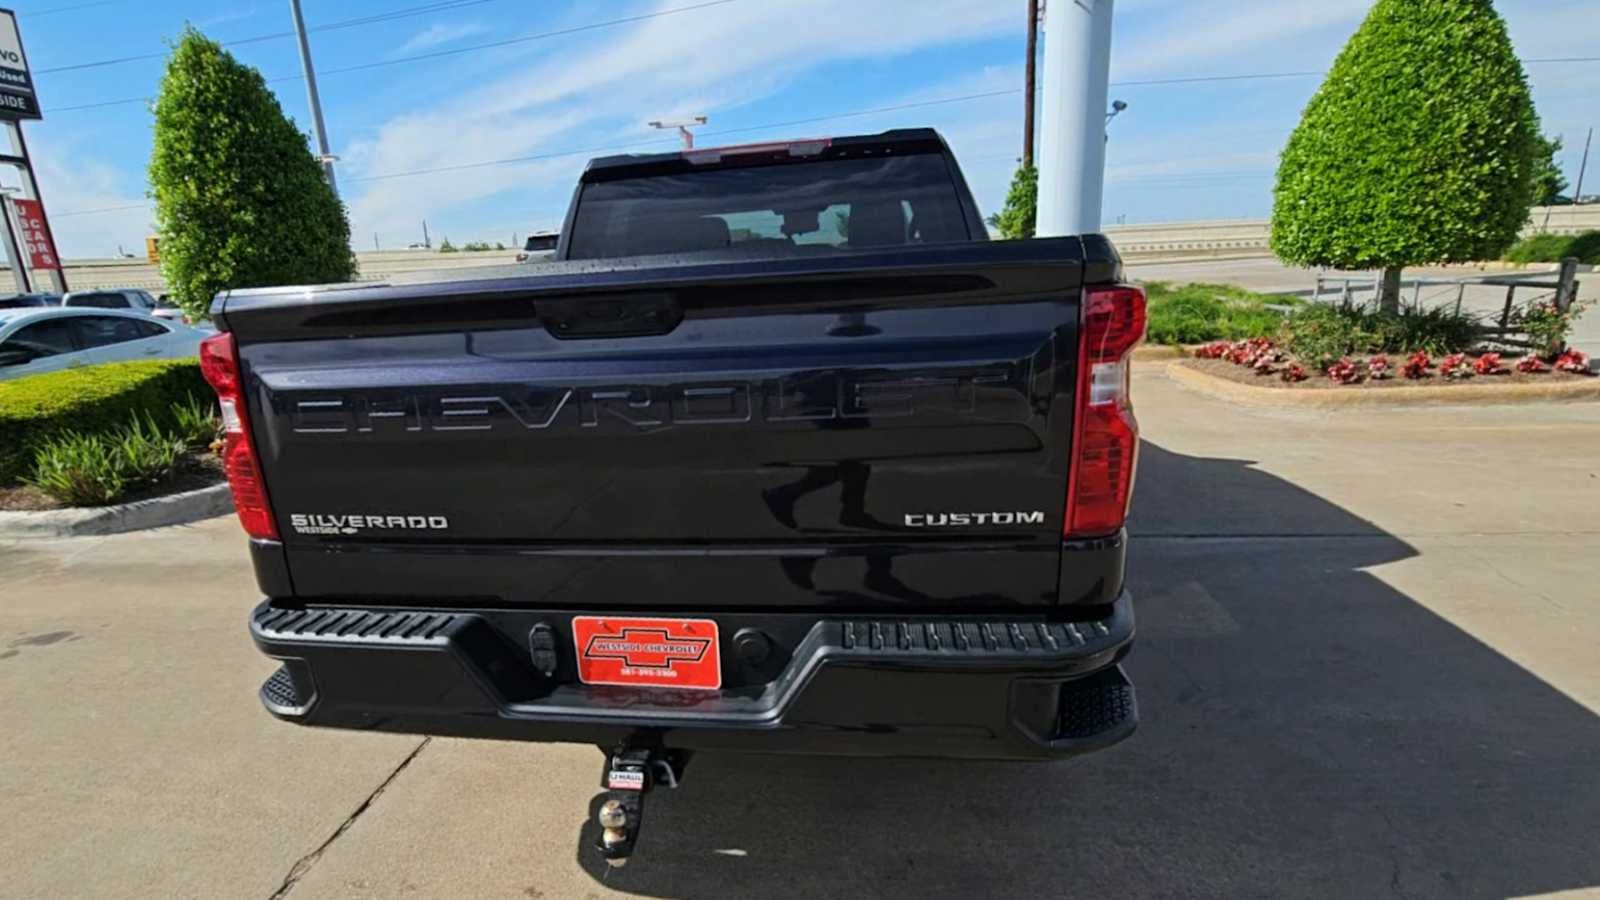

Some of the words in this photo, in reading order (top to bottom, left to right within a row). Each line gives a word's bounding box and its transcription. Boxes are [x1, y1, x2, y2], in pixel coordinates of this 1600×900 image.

[292, 374, 1009, 432] CHEVROLET
[291, 514, 448, 529] SILVERADO
[905, 511, 1045, 527] CUSTOM
[294, 526, 340, 535] WESTSIDE
[596, 642, 641, 651] WESTSIDE
[643, 644, 698, 654] CHEVROLET
